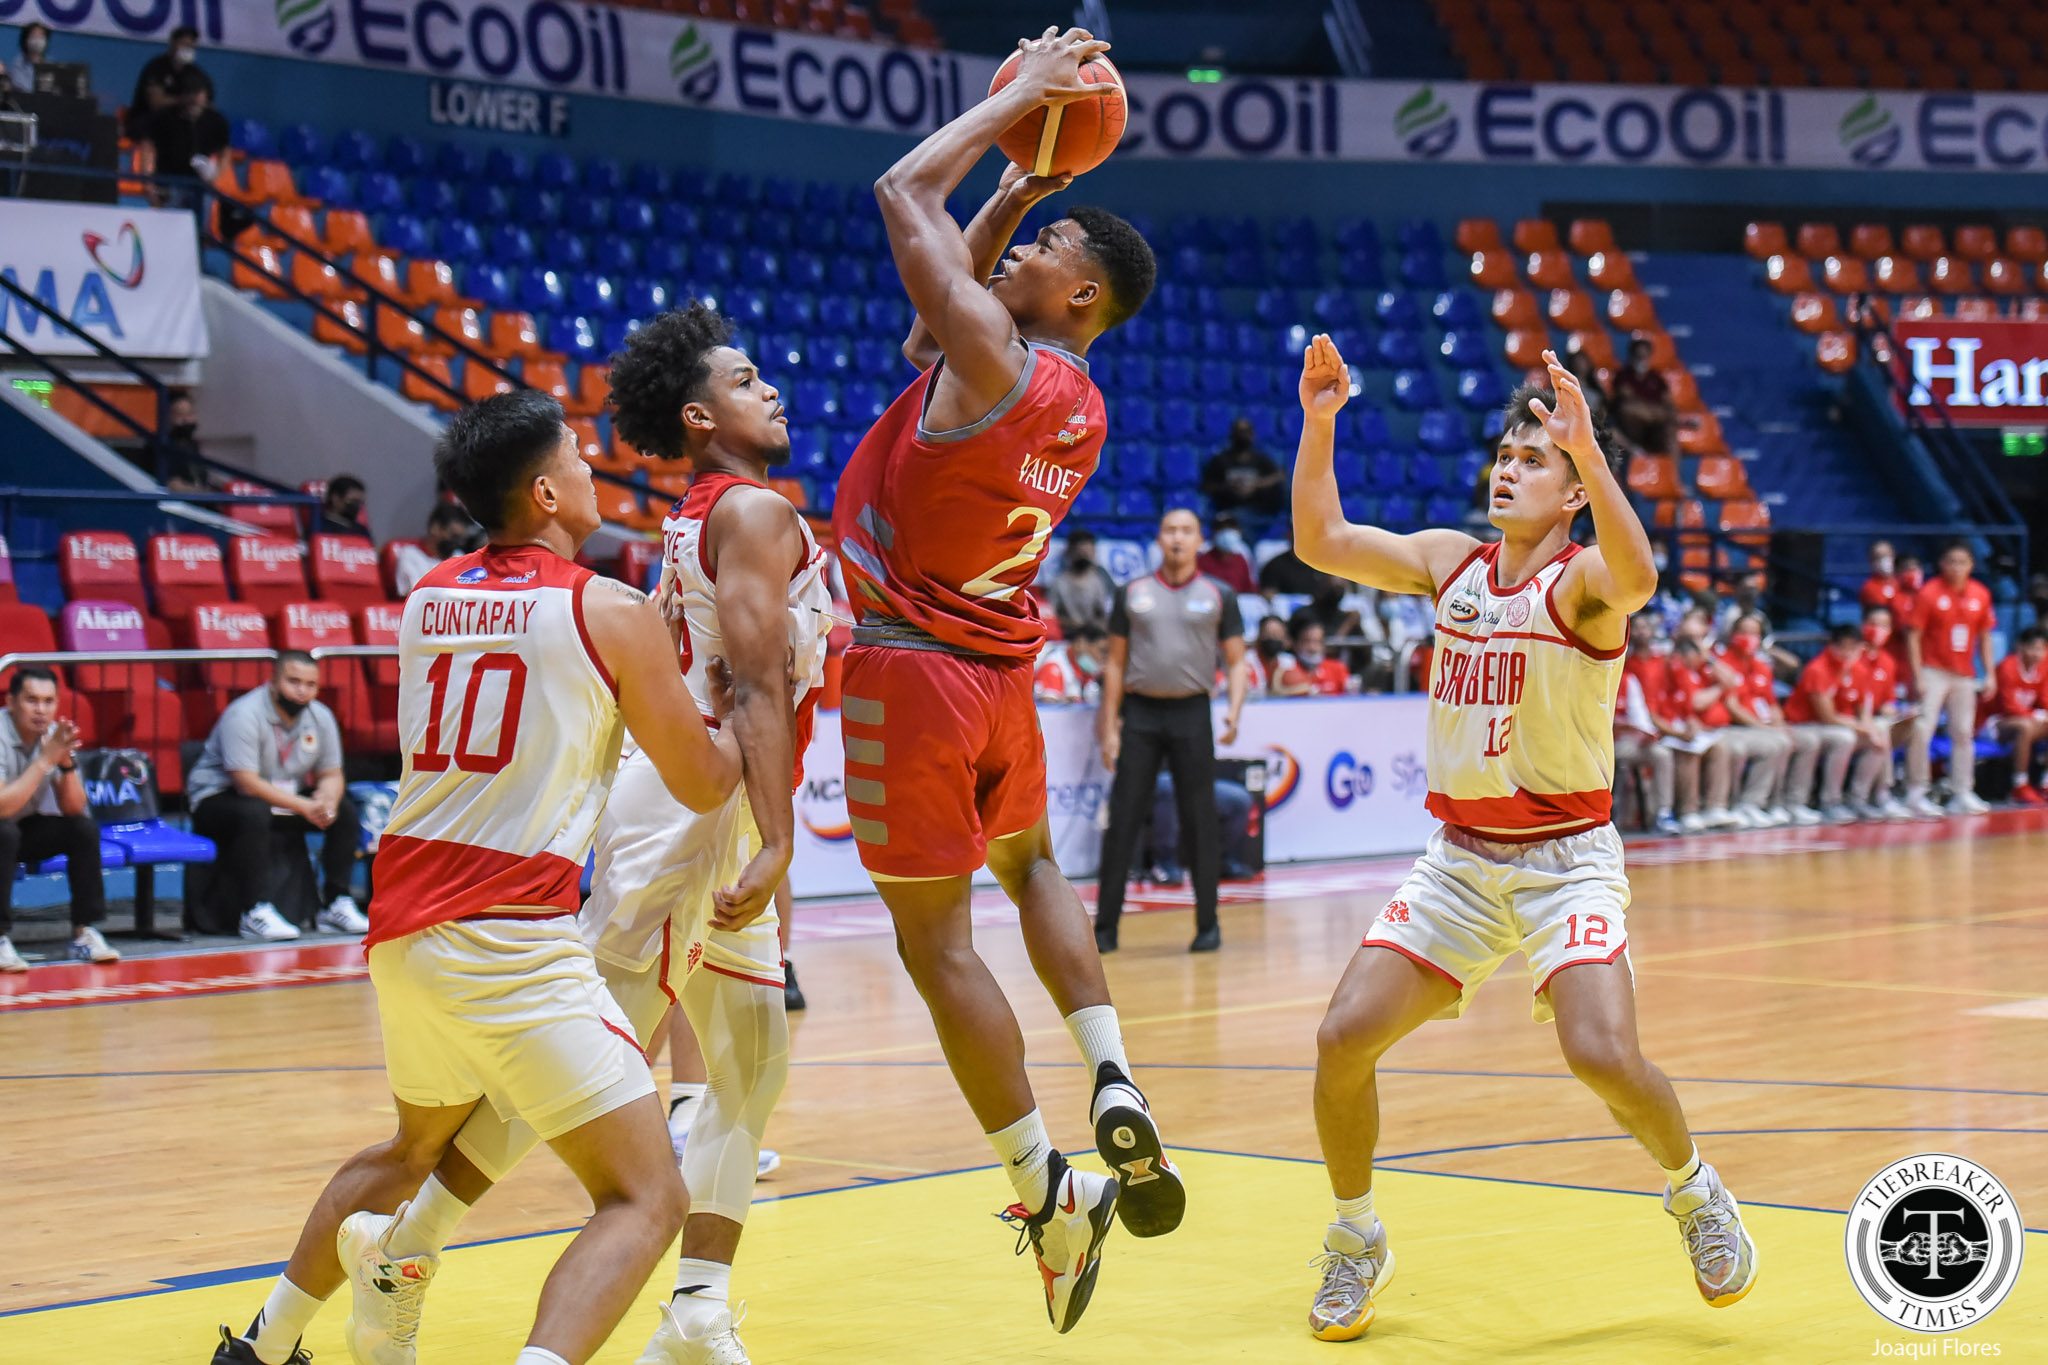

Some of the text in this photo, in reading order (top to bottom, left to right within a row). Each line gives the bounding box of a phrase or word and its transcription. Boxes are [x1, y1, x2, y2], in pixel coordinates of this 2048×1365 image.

[353, 0, 627, 92] EcoOil
[732, 26, 963, 130] EcoOil
[430, 81, 542, 134] LOWER
[1475, 86, 1786, 164] EcoOil
[1018, 452, 1084, 500] VALDEZ
[960, 506, 1052, 602] 2
[421, 600, 537, 635] CUNTAPAY
[1450, 602, 1472, 615] NCAA
[412, 652, 528, 775] 10
[1483, 714, 1513, 757] 12
[1564, 913, 1609, 950] 12
